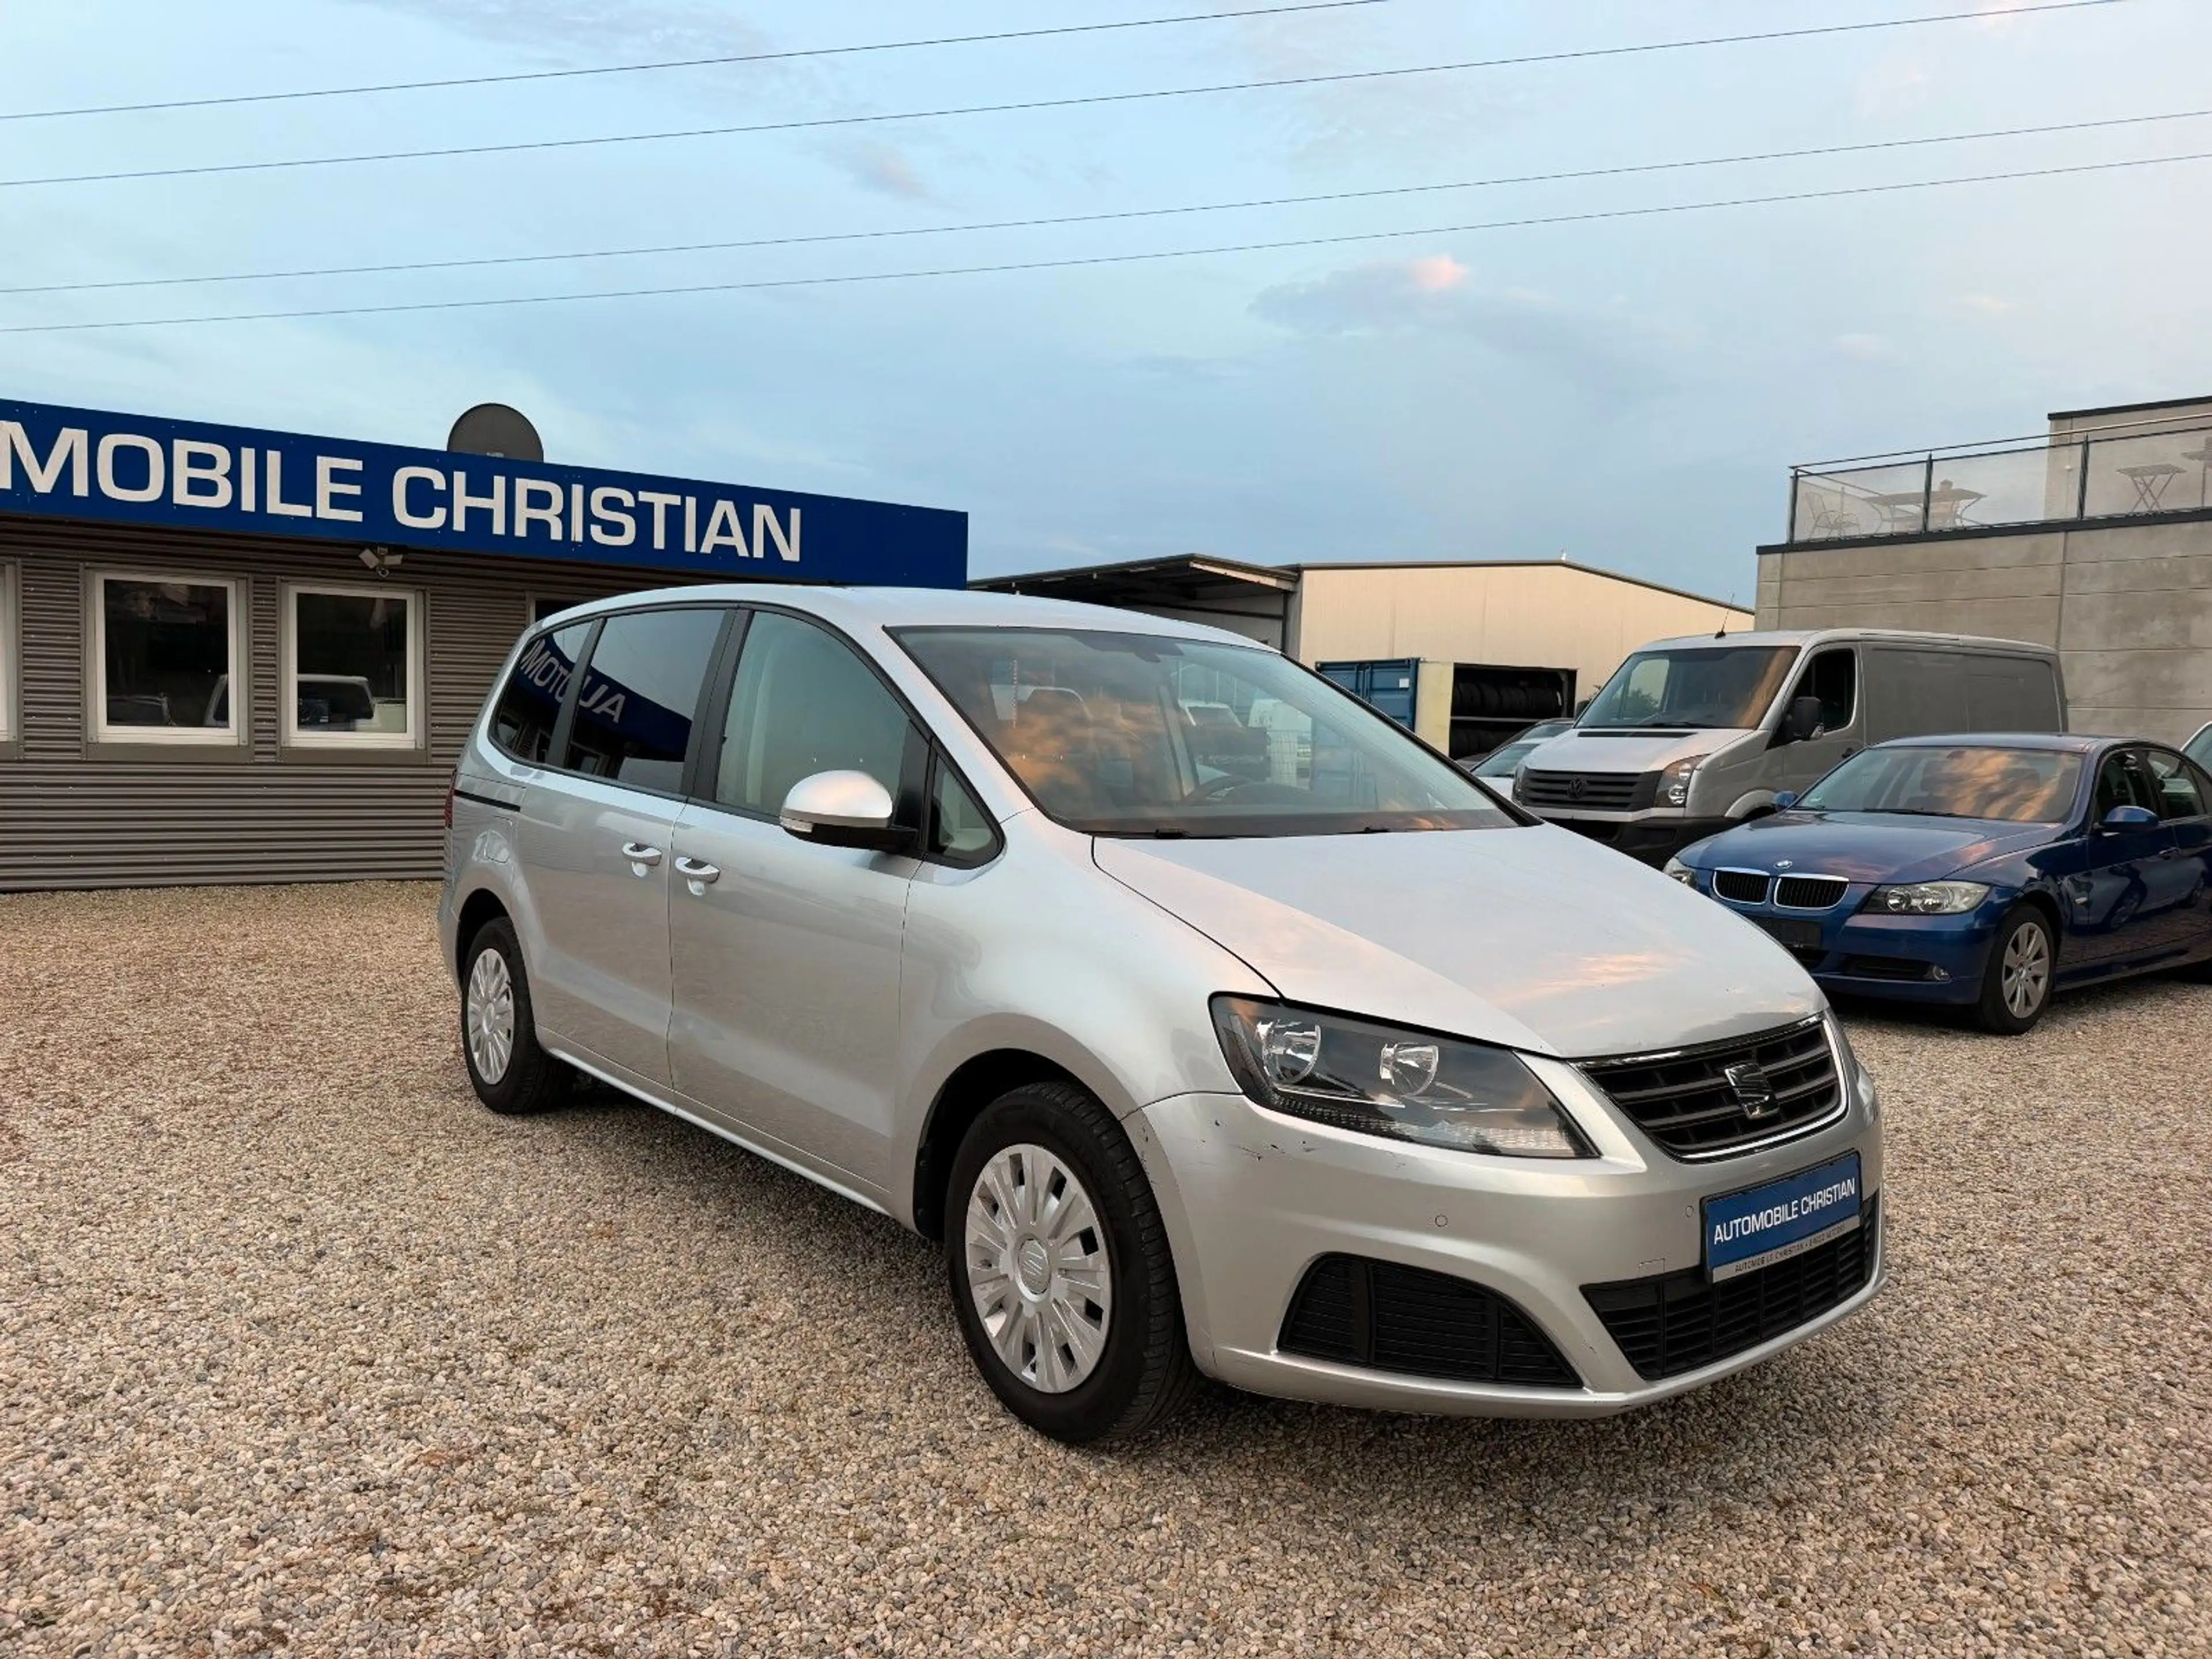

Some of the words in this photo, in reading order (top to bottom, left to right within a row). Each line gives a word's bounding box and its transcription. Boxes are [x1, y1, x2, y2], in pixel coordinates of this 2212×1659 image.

[0, 420, 363, 522] MOBILE
[392, 466, 801, 562] CHRISTIAN
[1714, 1200, 1798, 1245] AUTOMOBILE
[1801, 1177, 1855, 1215] CHRISTIAN
